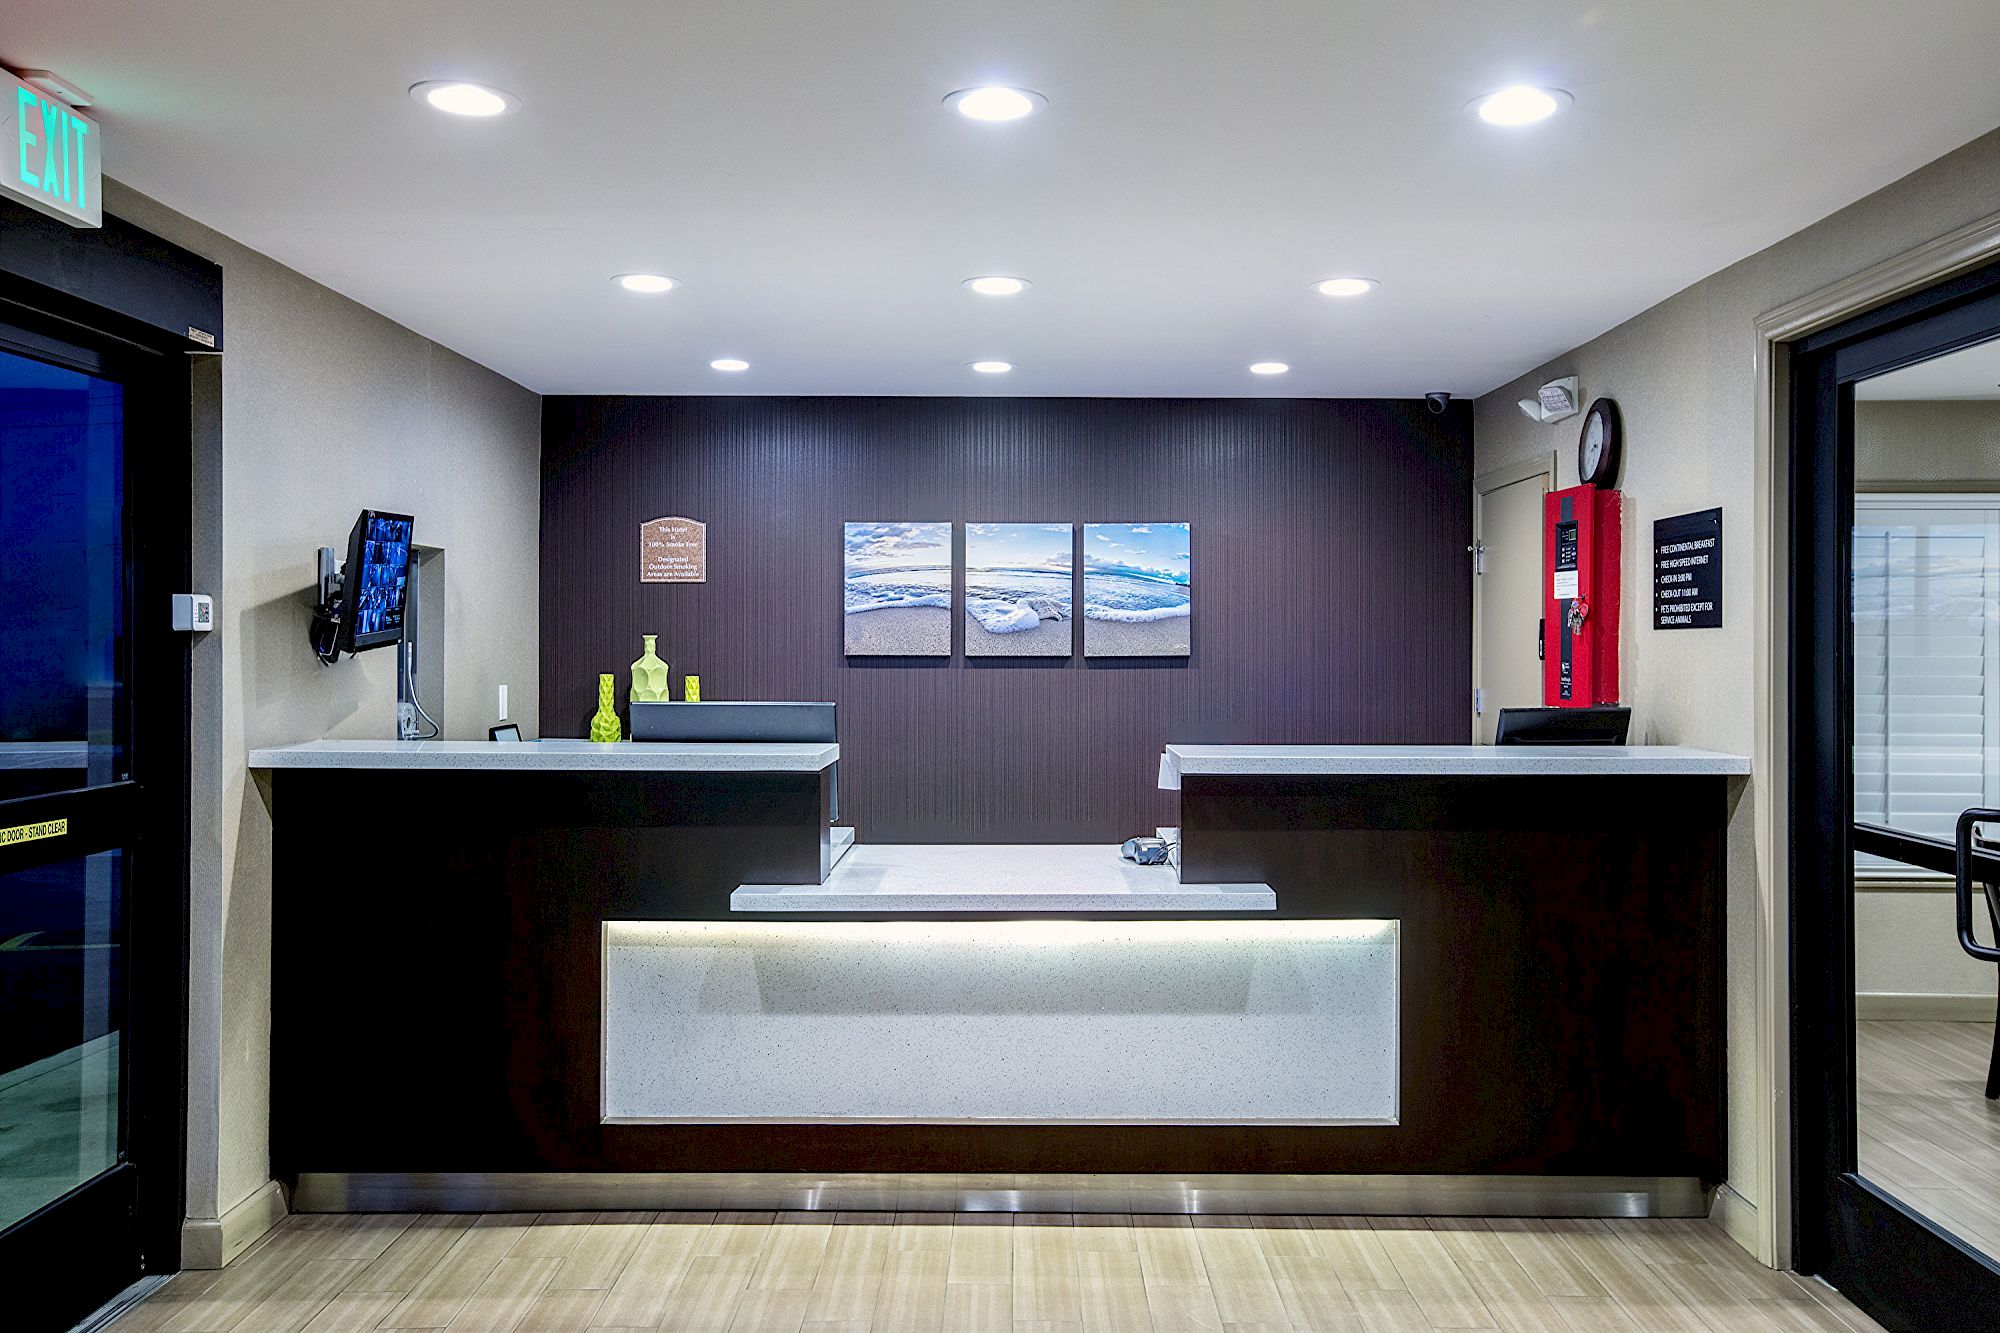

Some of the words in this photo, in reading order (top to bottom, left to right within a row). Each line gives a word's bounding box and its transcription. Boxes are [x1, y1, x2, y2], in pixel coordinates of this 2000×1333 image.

[17, 86, 89, 209] EXIT
[1661, 545, 1670, 554] FREE
[1670, 541, 1694, 553] CONTINENTAL
[1694, 537, 1716, 550] BREAKFAST
[657, 556, 689, 564] Designated
[1661, 560, 1670, 569] FREE
[1691, 554, 1709, 566] INTERNET
[674, 563, 698, 571] Smoking
[1661, 589, 1681, 598] CHECK-OUT
[1661, 605, 1670, 613] PETS
[1670, 603, 1690, 612] PROHIBITED
[1691, 602, 1704, 612] EXCEPT
[1705, 601, 1713, 611] FOR
[1661, 615, 1675, 624] SERVICE
[1675, 615, 1692, 624] ANIMALS
[7, 828, 24, 842] DOOR
[28, 824, 47, 839] STAND
[47, 821, 66, 835] CLEAR
